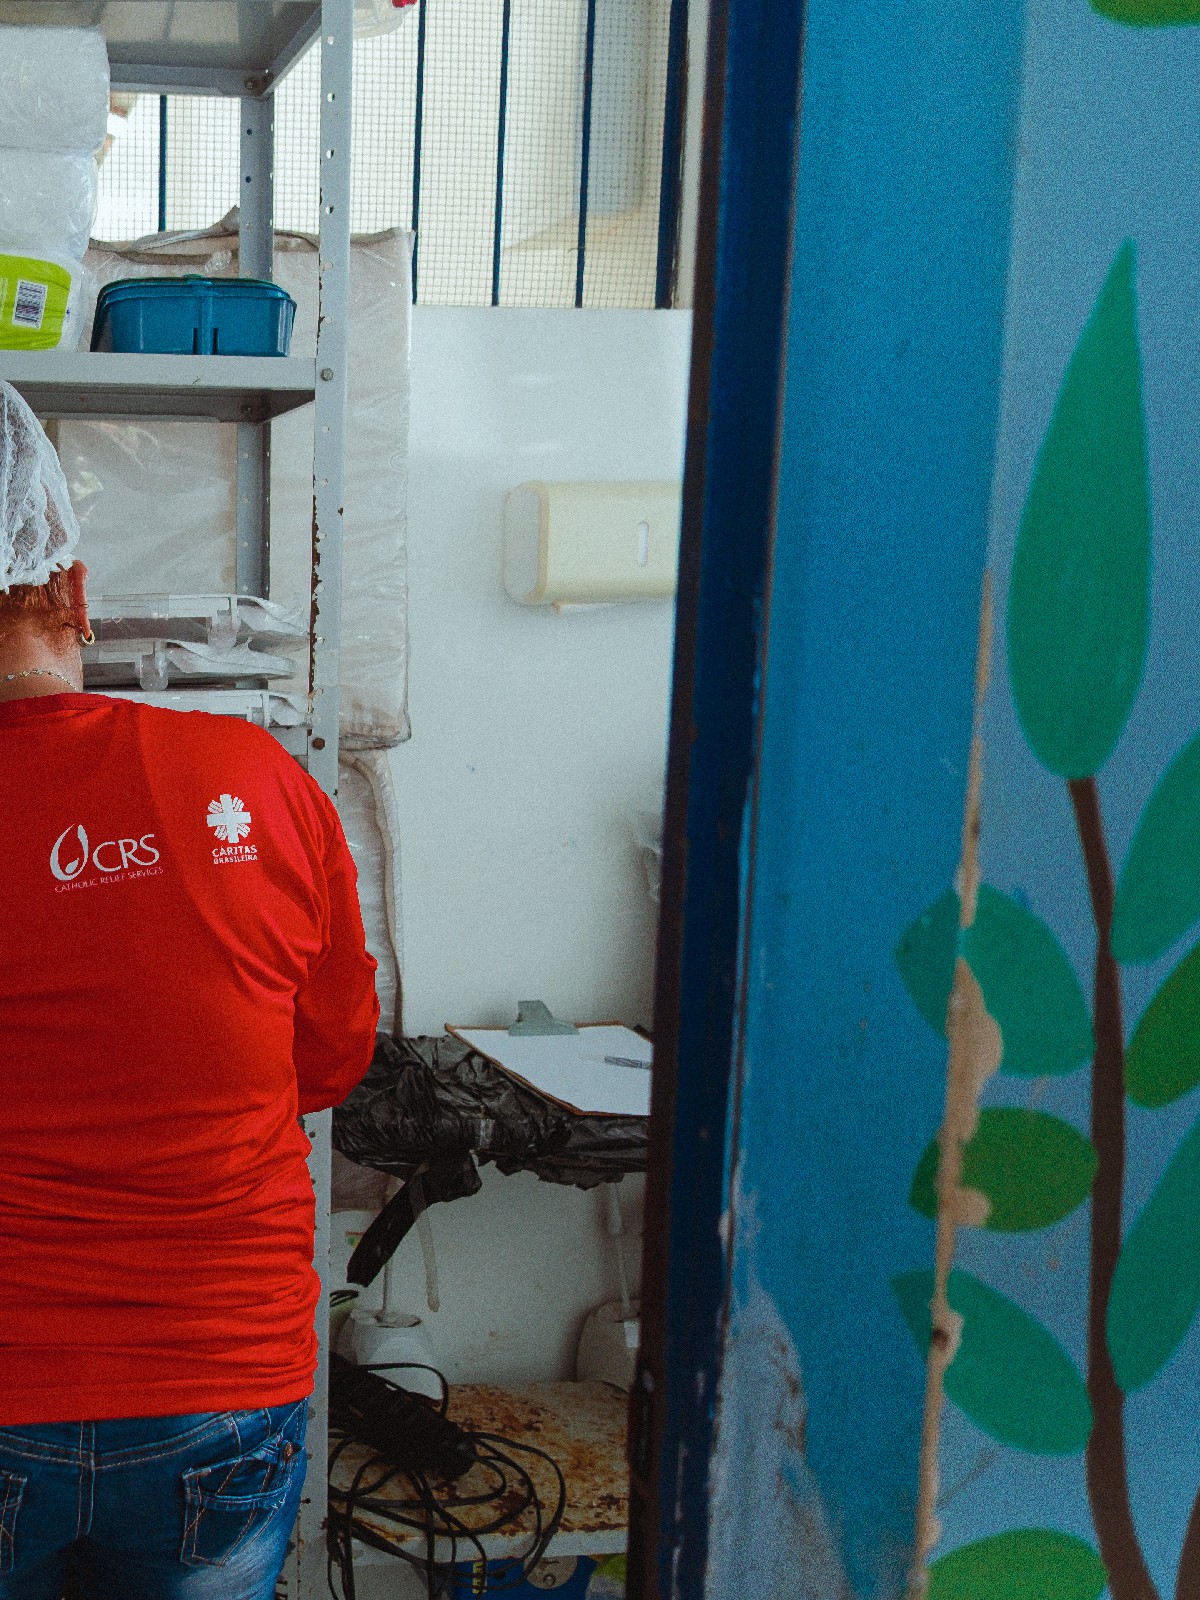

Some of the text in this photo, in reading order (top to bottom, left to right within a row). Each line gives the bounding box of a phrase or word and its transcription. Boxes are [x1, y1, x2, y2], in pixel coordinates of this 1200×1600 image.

[93, 833, 160, 872] CRS
[213, 854, 258, 865] BRASILEIRA
[55, 866, 164, 893] CATHOLIC RELIEF SERVICES
